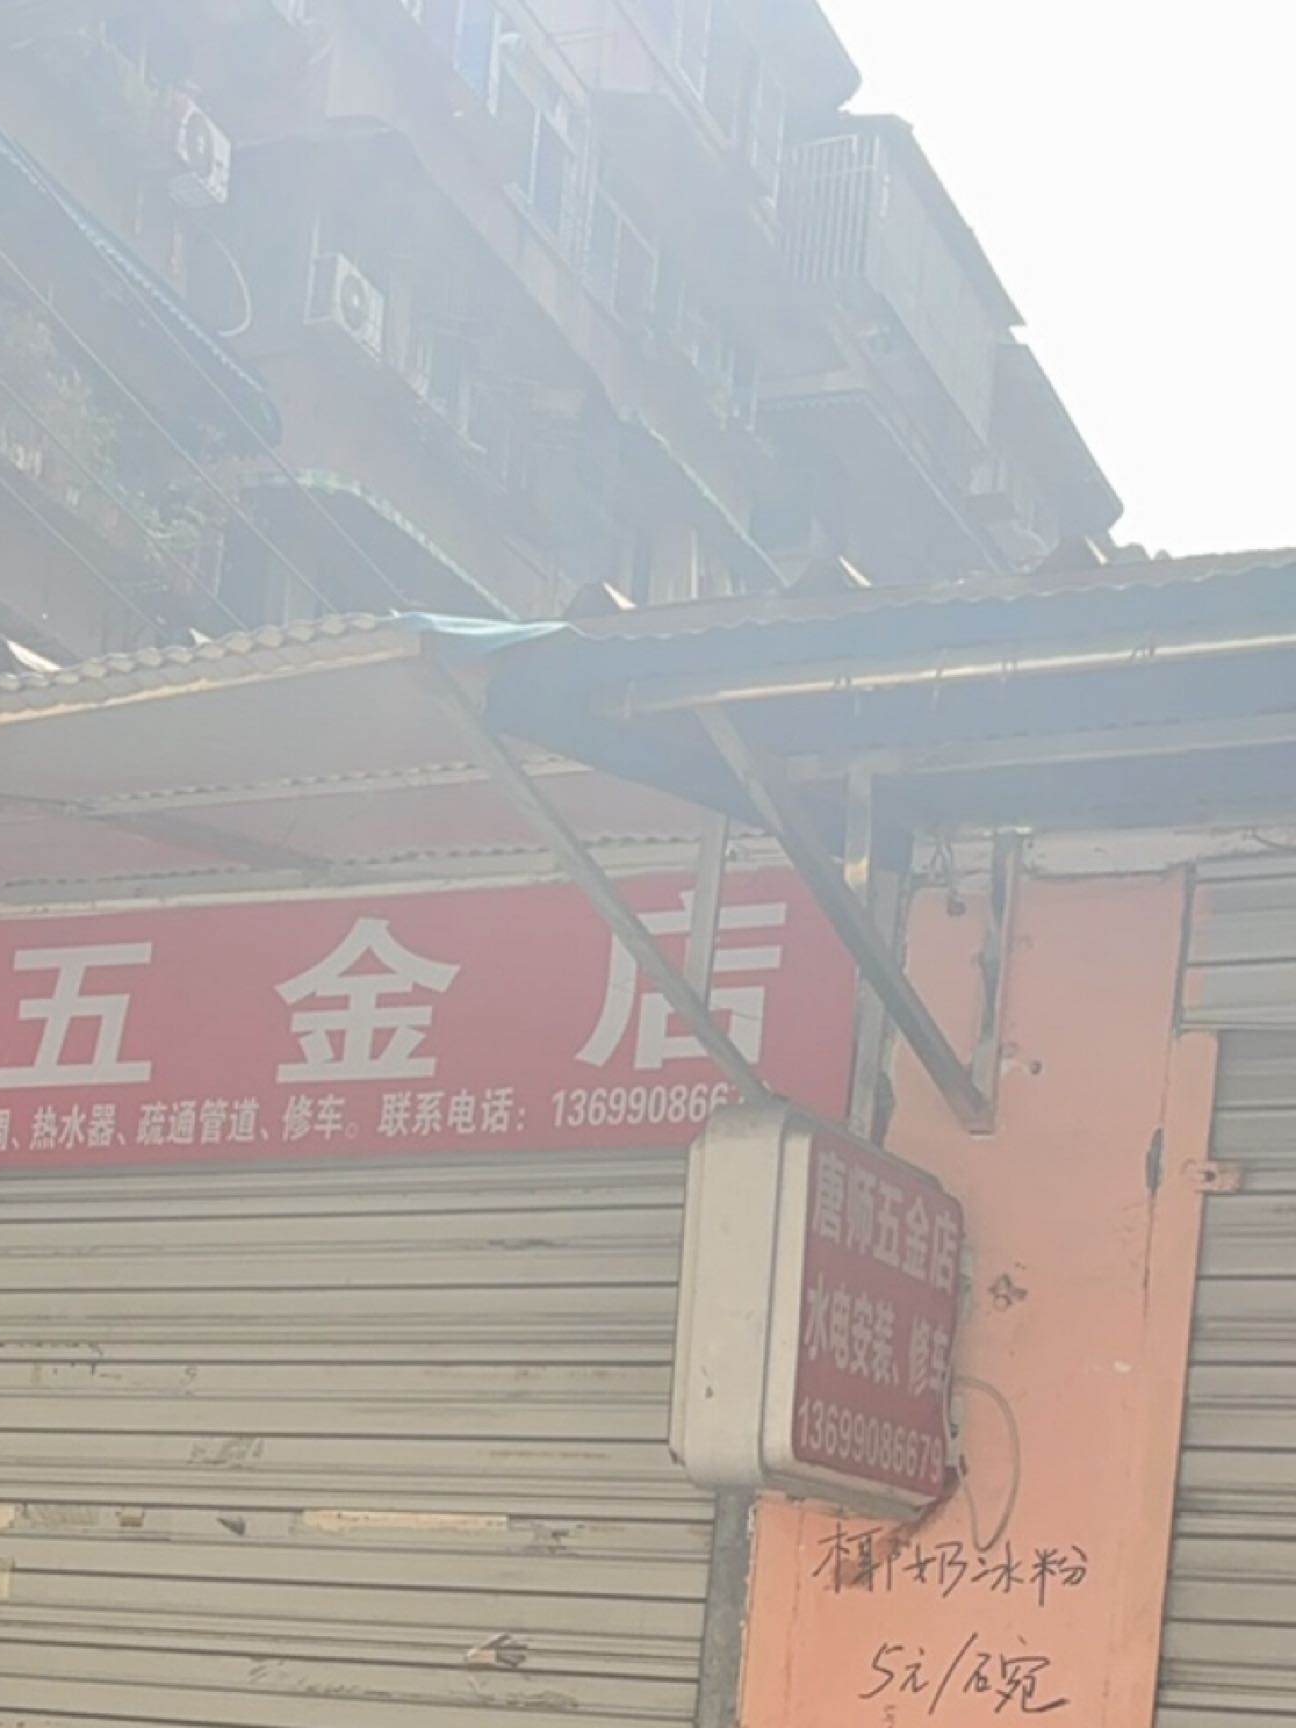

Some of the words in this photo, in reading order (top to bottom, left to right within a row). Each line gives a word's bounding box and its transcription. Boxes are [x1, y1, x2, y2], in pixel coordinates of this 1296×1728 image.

[812, 1150, 955, 1295] 唐师五金店
[797, 1395, 945, 1485] 13699086679
[857, 1632, 1071, 1716] 5元/碗
